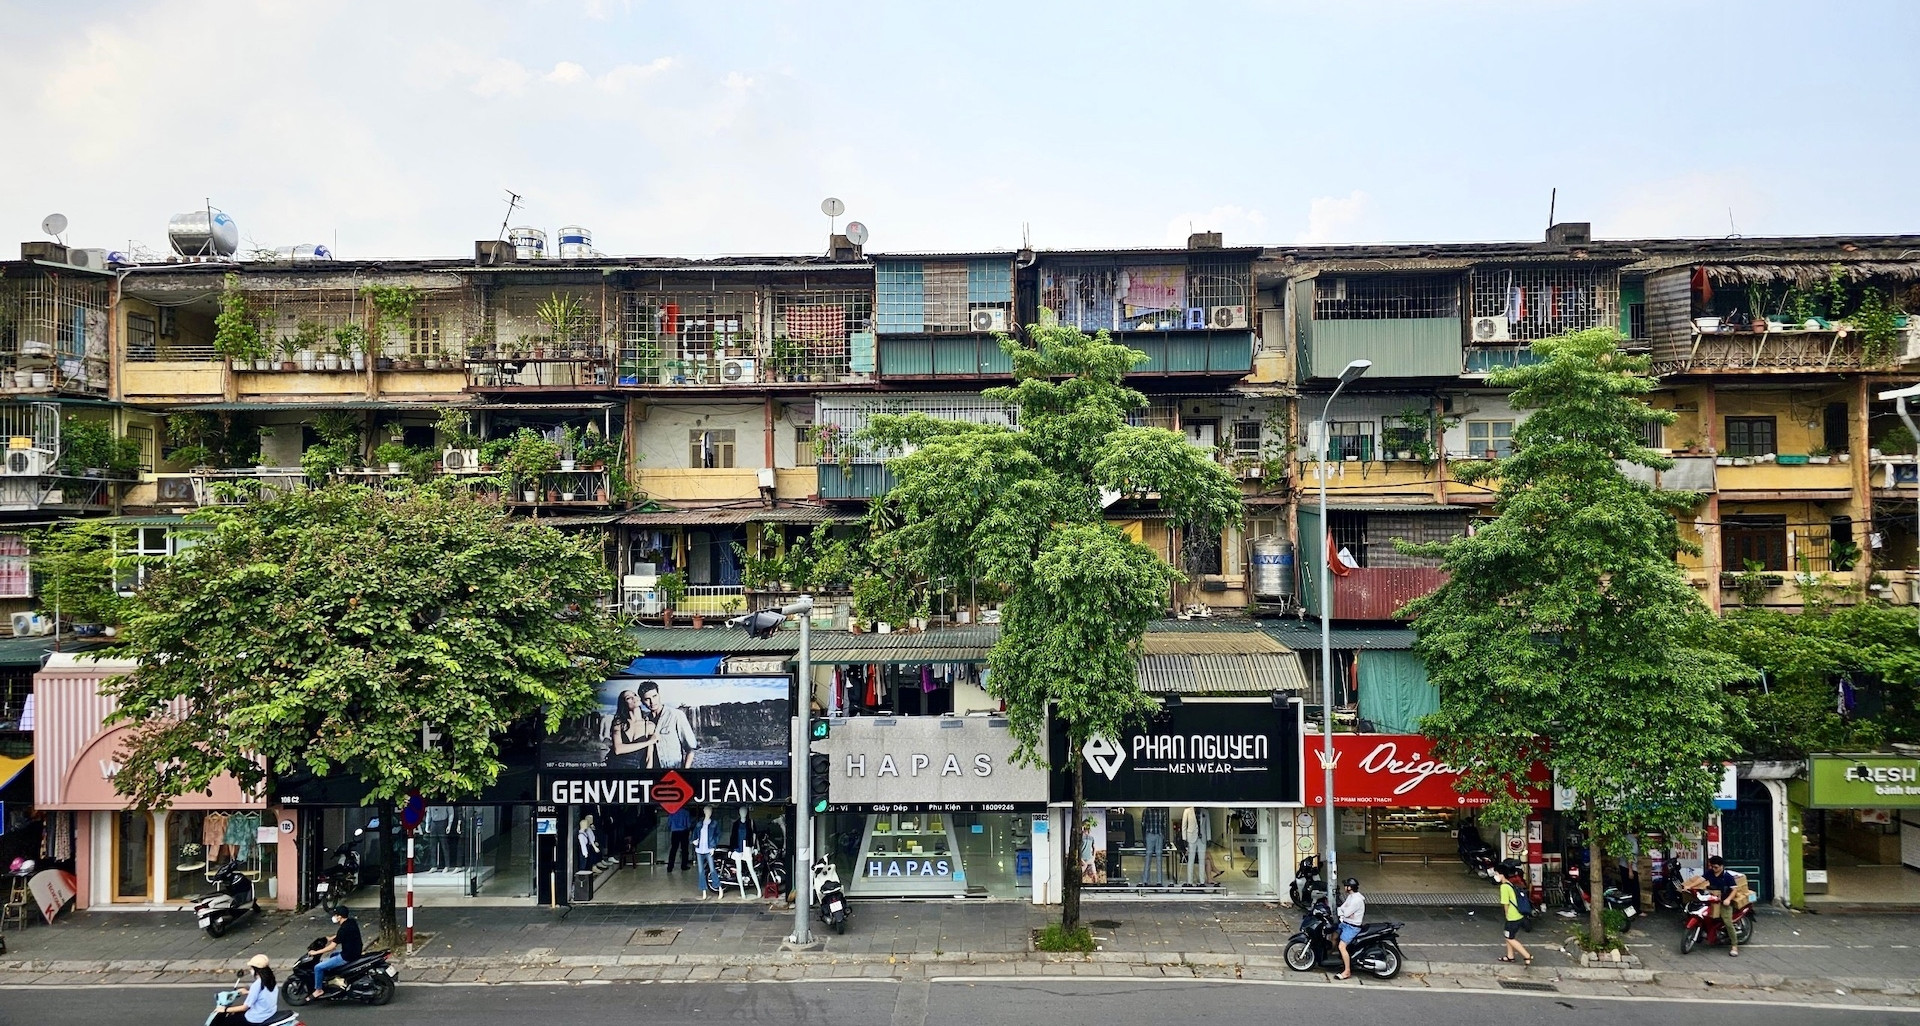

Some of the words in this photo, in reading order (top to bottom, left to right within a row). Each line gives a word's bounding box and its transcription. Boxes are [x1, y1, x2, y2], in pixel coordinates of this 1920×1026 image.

[164, 480, 187, 499] C2
[1133, 735, 1185, 759] PHAN
[1191, 735, 1268, 759] NGUYEN
[846, 753, 993, 777] HAPAS
[1169, 763, 1195, 773] MEN
[1197, 763, 1232, 773] WEAR
[1846, 767, 1916, 782] FRESH
[552, 780, 653, 803] GENVIET
[694, 778, 774, 802] JEANS
[1875, 785, 1904, 795] bánh
[870, 861, 949, 877] HAPAS
